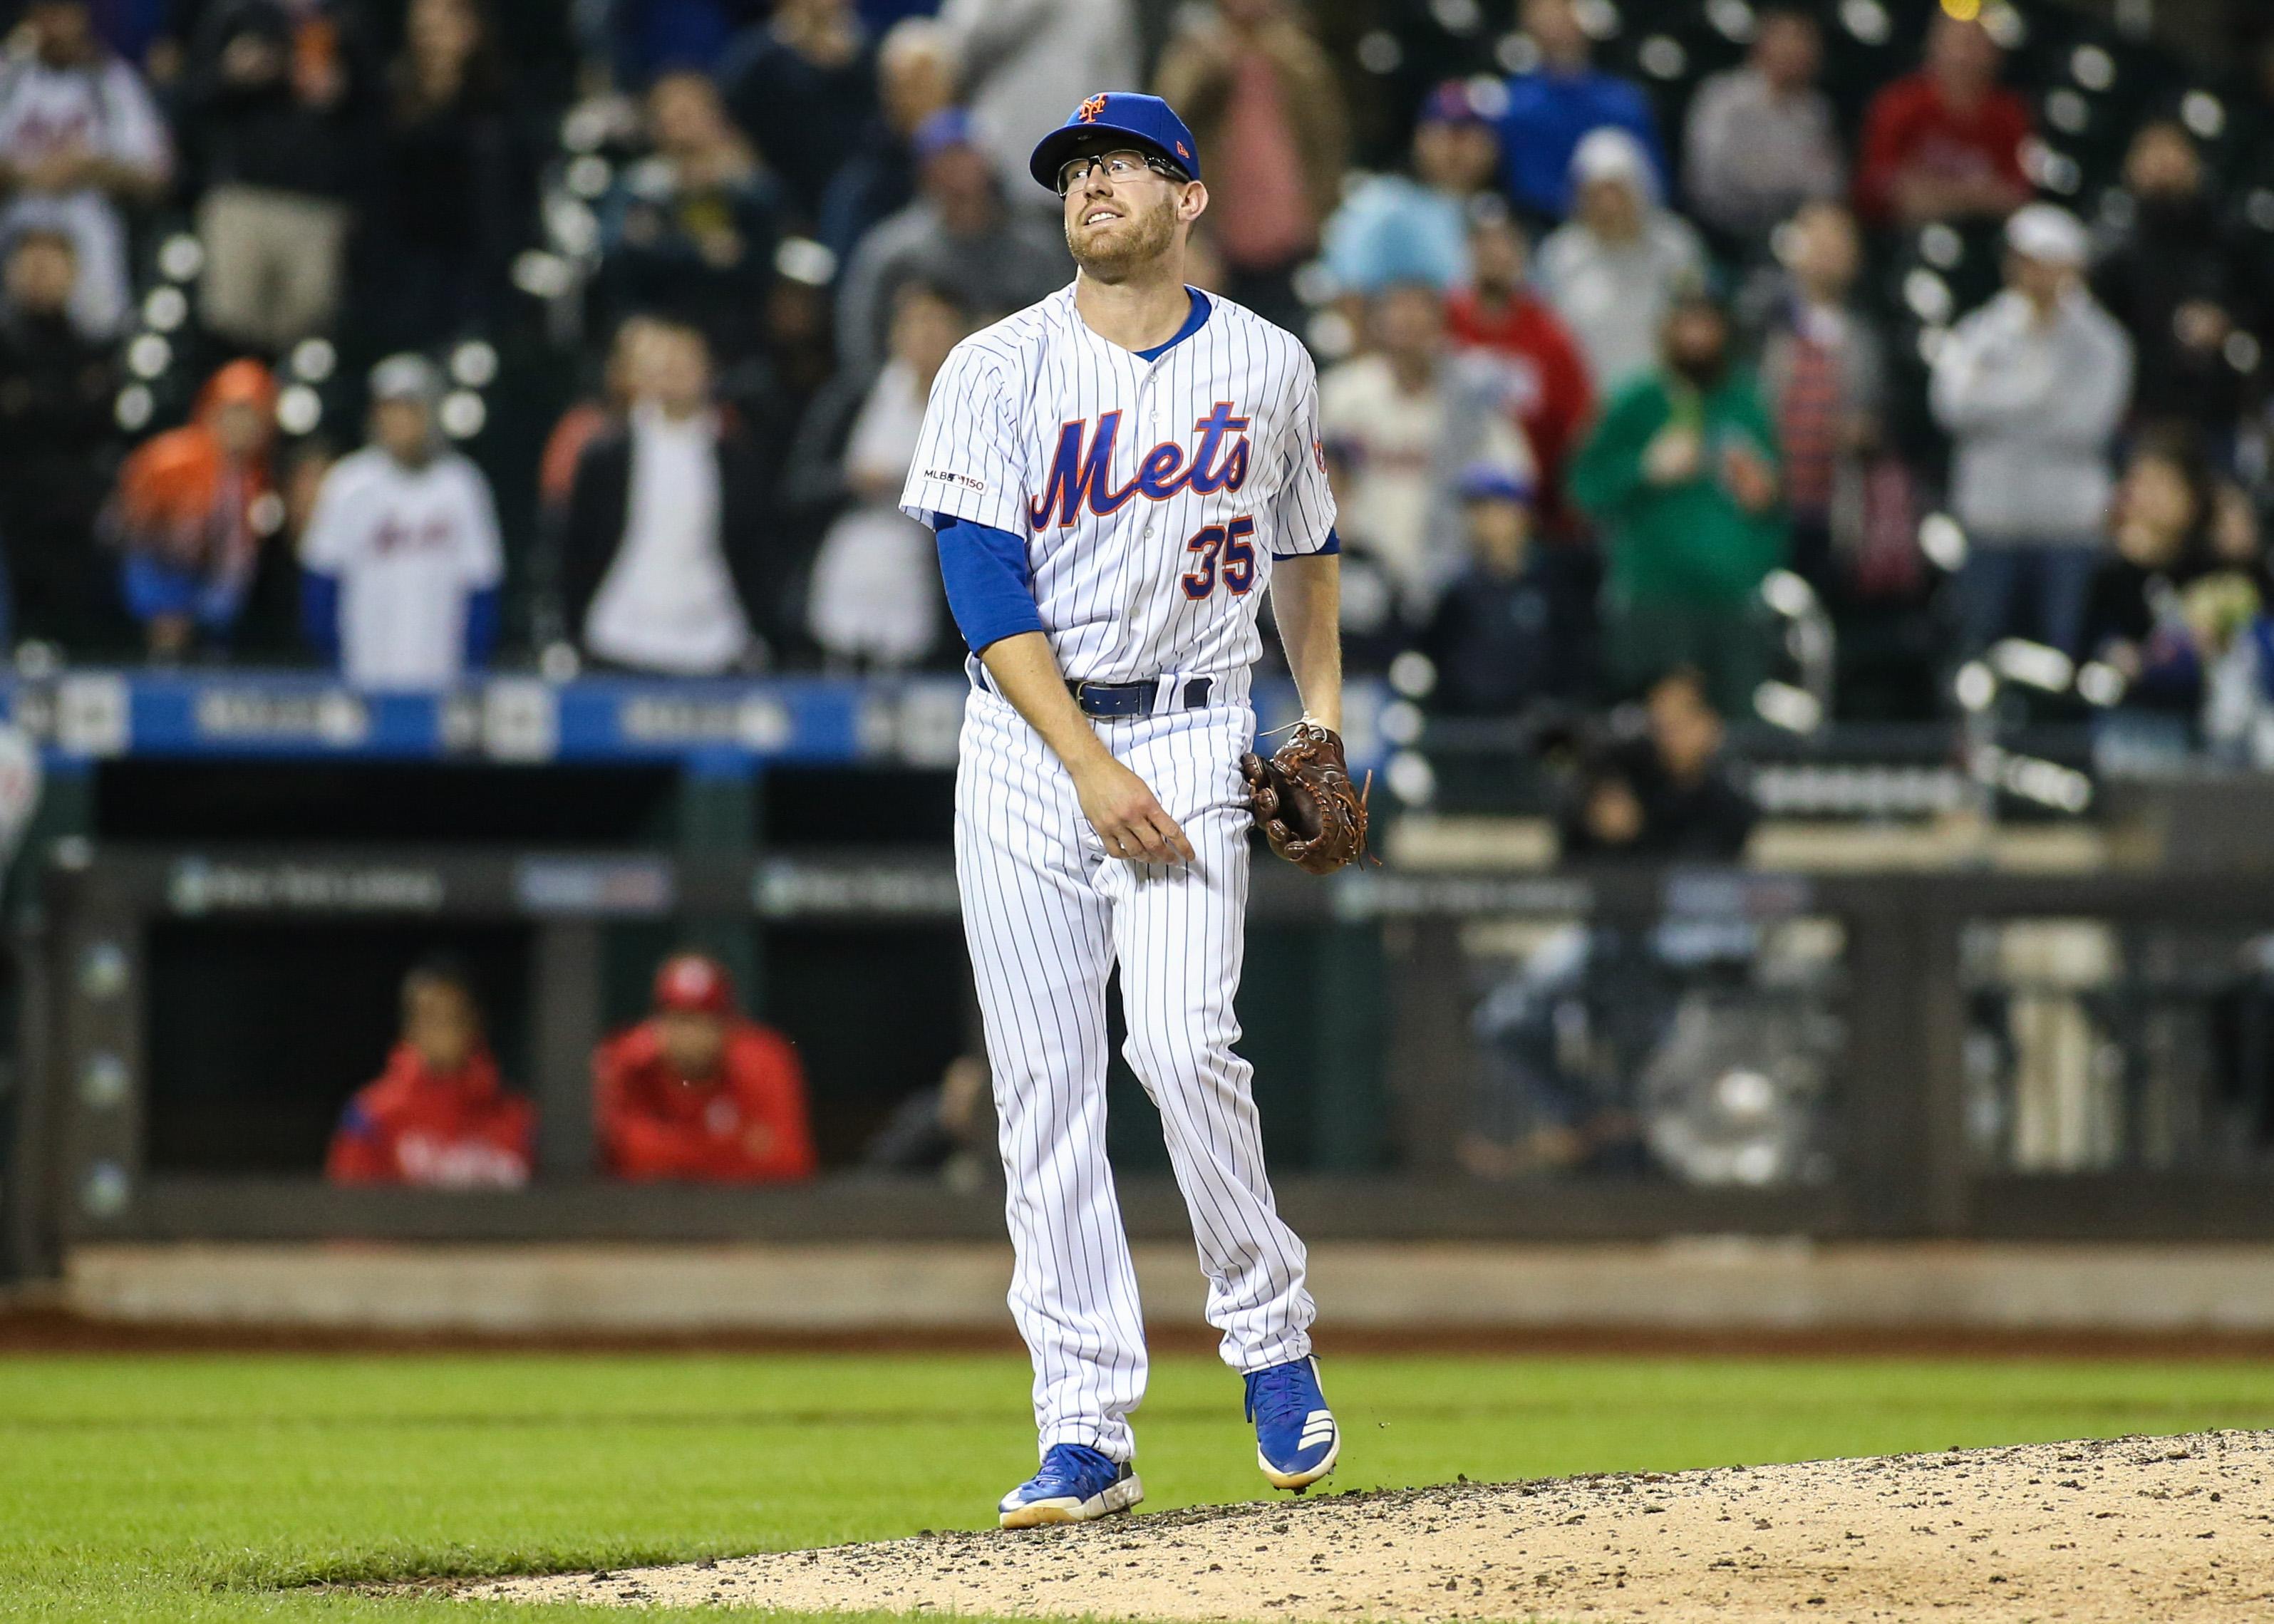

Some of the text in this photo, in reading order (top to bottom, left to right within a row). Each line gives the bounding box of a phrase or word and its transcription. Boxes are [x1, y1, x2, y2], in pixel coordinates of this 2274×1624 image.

[924, 470, 984, 491] MLB 150
[1030, 401, 1251, 532] Mets
[1182, 514, 1256, 600] 35
